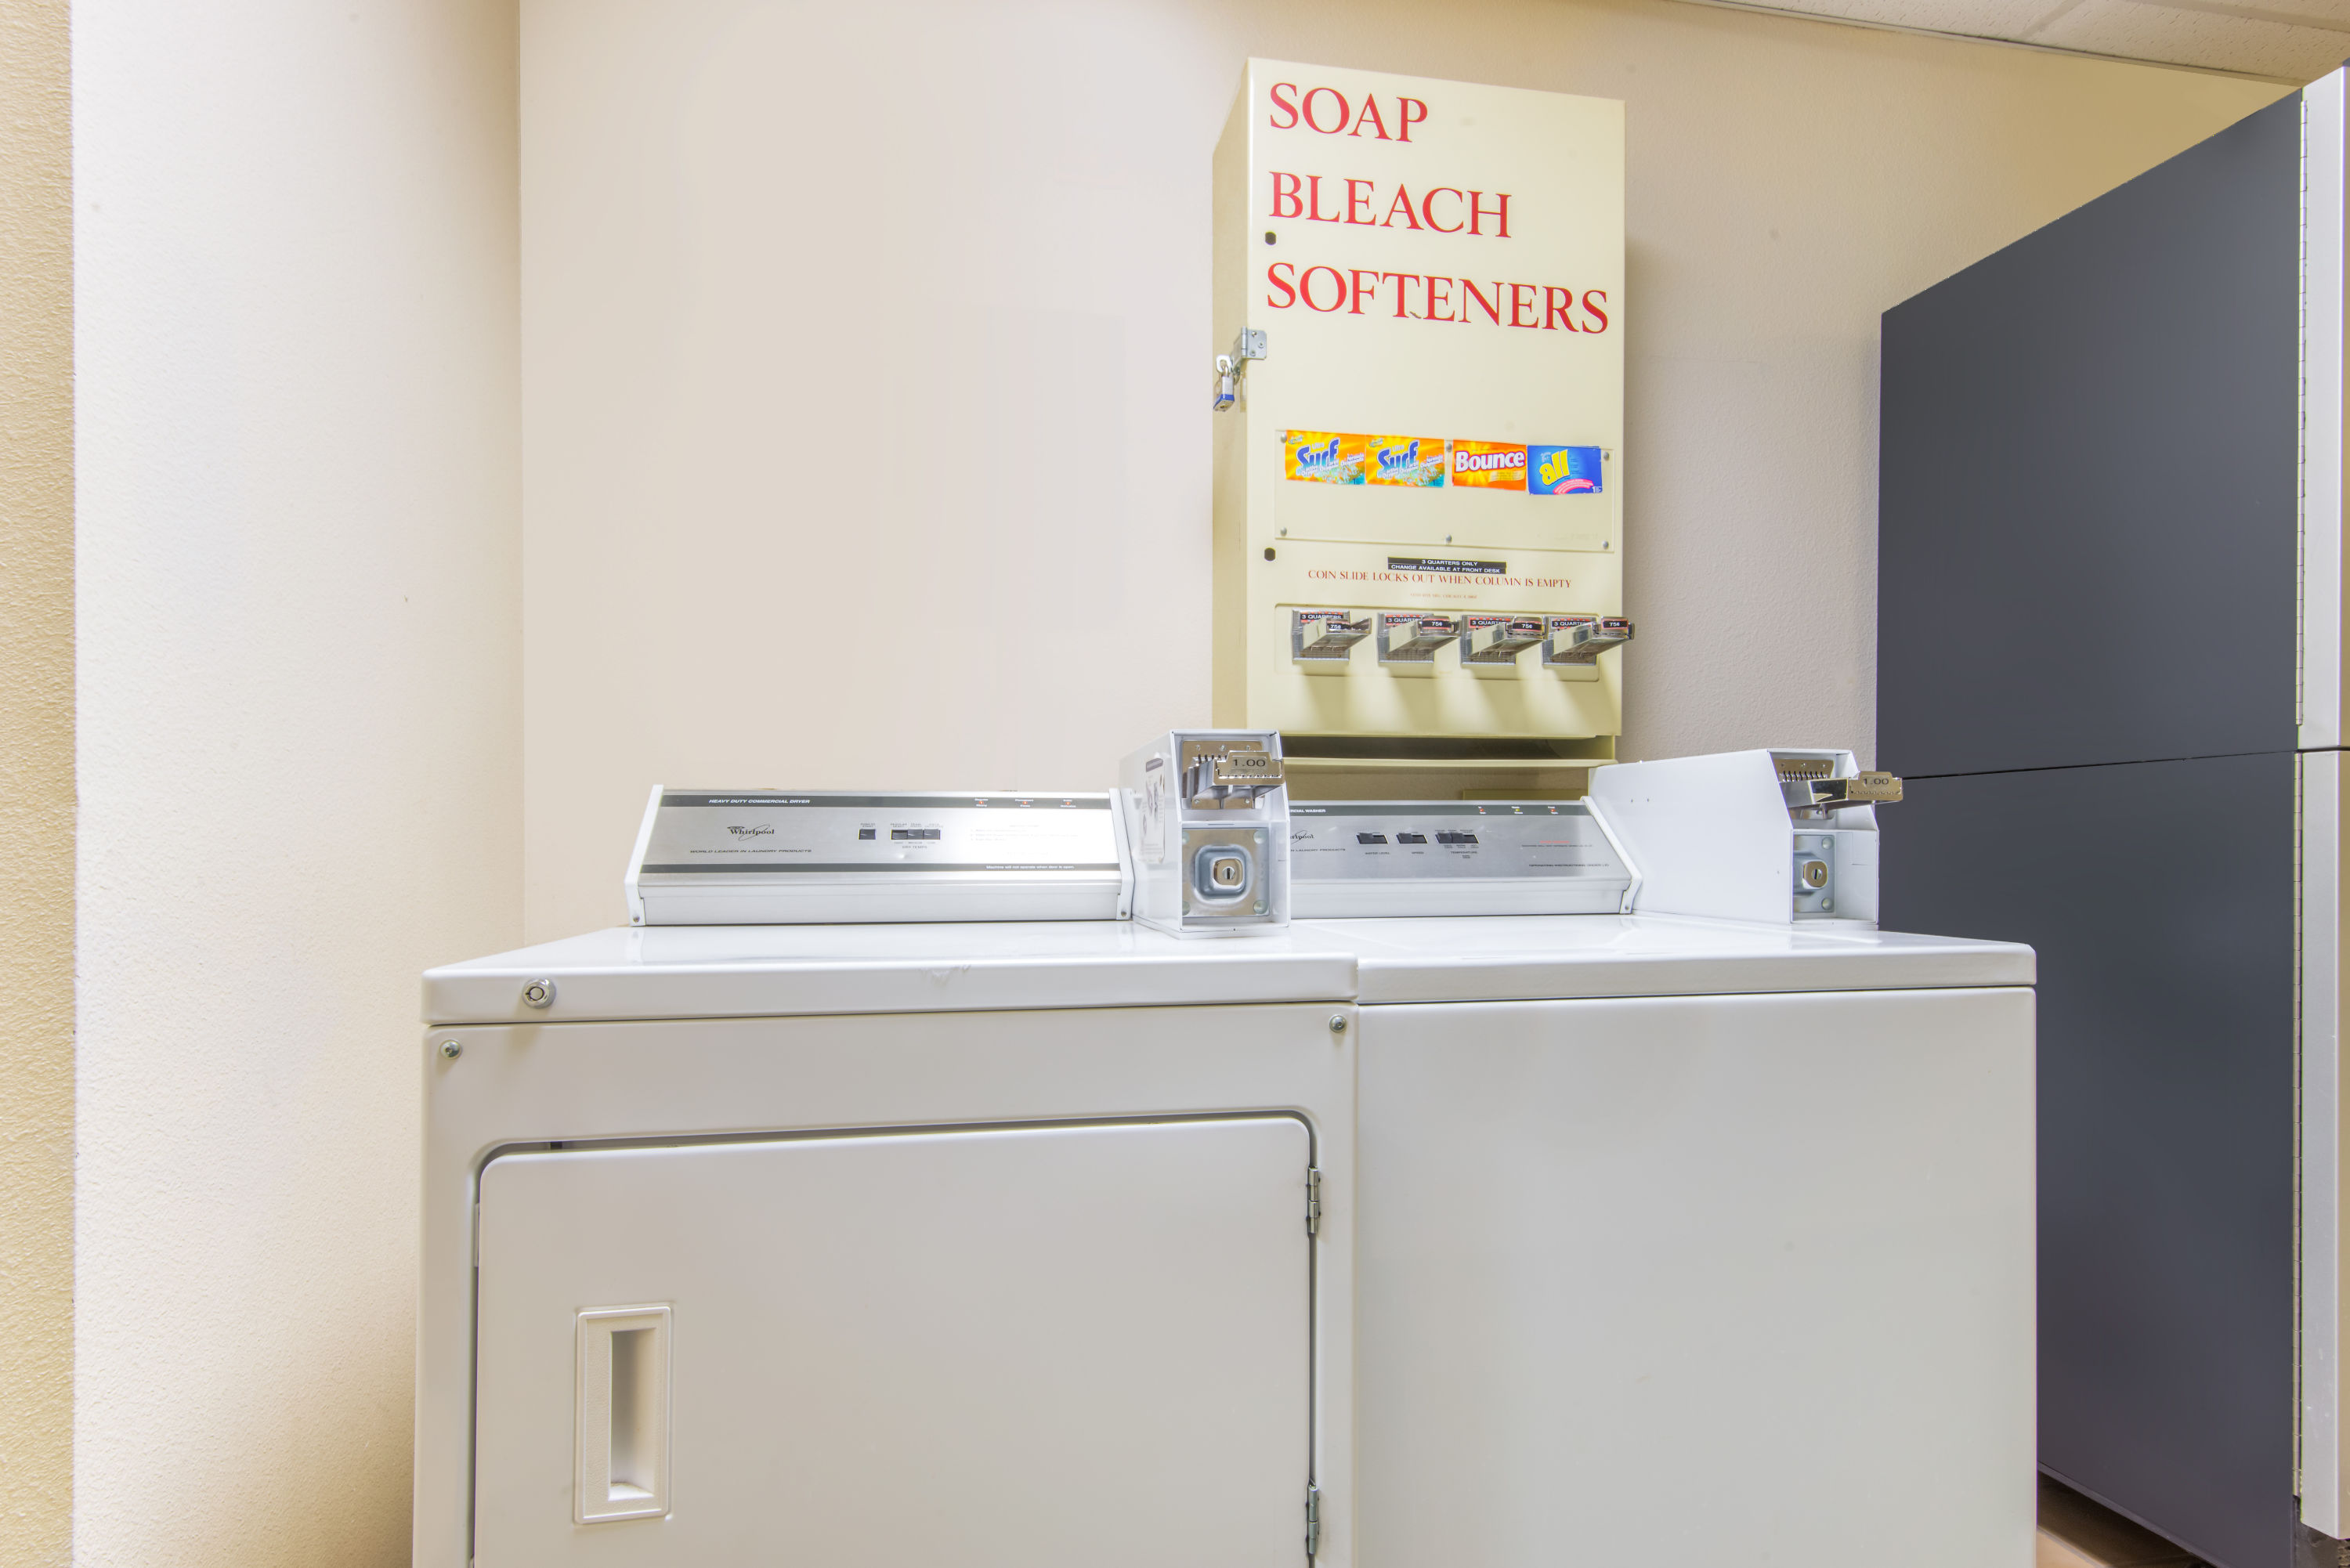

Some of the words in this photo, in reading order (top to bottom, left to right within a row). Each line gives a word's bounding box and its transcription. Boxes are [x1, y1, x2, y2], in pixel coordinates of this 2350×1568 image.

[1270, 82, 1428, 143] SOAP
[1268, 172, 1512, 238] BLEACH
[1267, 262, 1608, 334] SOFTENERS
[1296, 437, 1340, 476] Surf
[1377, 439, 1419, 478] Surf
[1455, 450, 1525, 472] Bounce
[1539, 449, 1570, 486] all
[1308, 569, 1336, 580] COIN
[1340, 571, 1369, 581] SLIDE
[1372, 572, 1408, 583] LOCKS
[1412, 573, 1435, 583] OUT
[1439, 574, 1472, 584] WHEN
[1475, 576, 1521, 587] COLUMN
[1525, 578, 1534, 587] IS
[1537, 579, 1571, 588] EMPTY
[1232, 758, 1266, 768] 1.00
